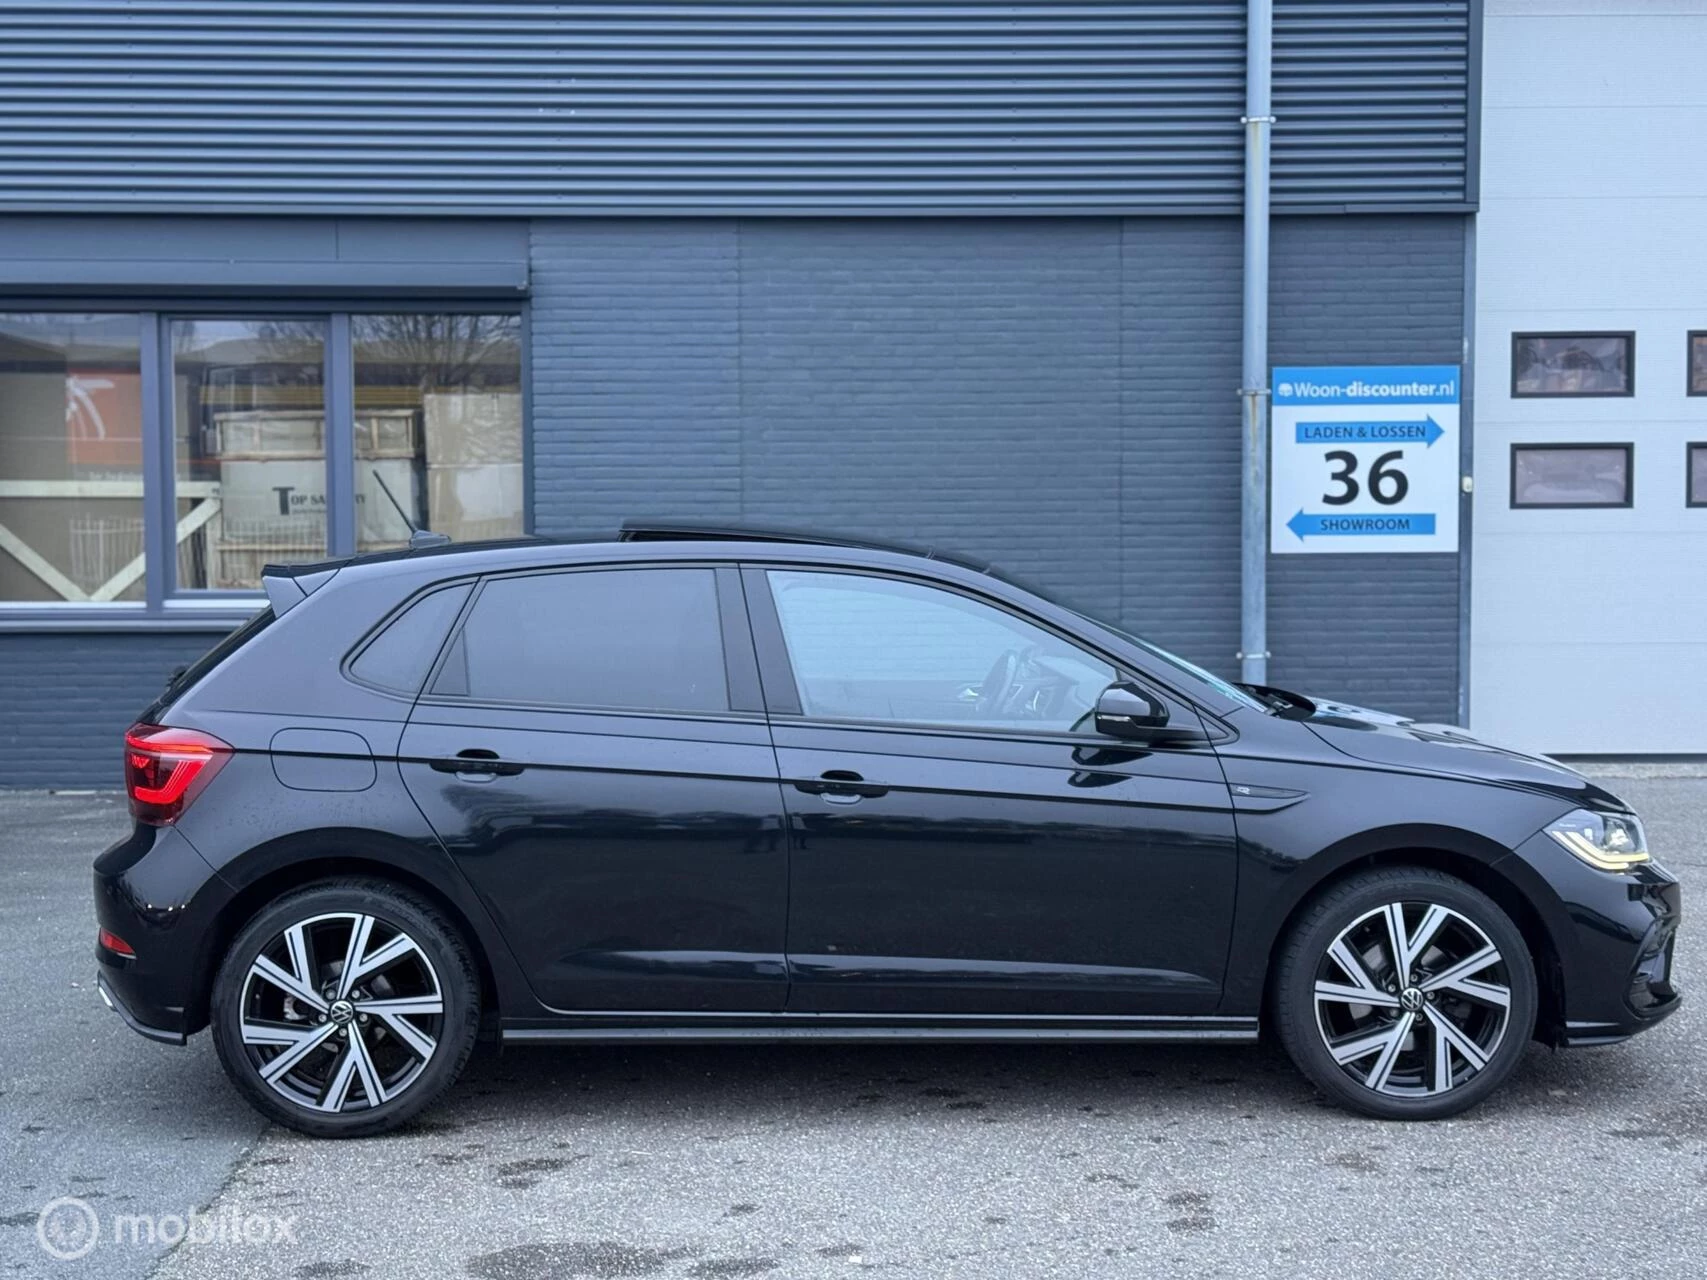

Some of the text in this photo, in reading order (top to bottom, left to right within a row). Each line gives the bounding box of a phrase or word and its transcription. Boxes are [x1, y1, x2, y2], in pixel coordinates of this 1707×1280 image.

[1294, 381, 1455, 397] Woon-discounter.nl
[1304, 426, 1426, 439] LADEN & LOSSEN
[1322, 450, 1409, 505] 36
[1320, 519, 1410, 531] SHOWROOM
